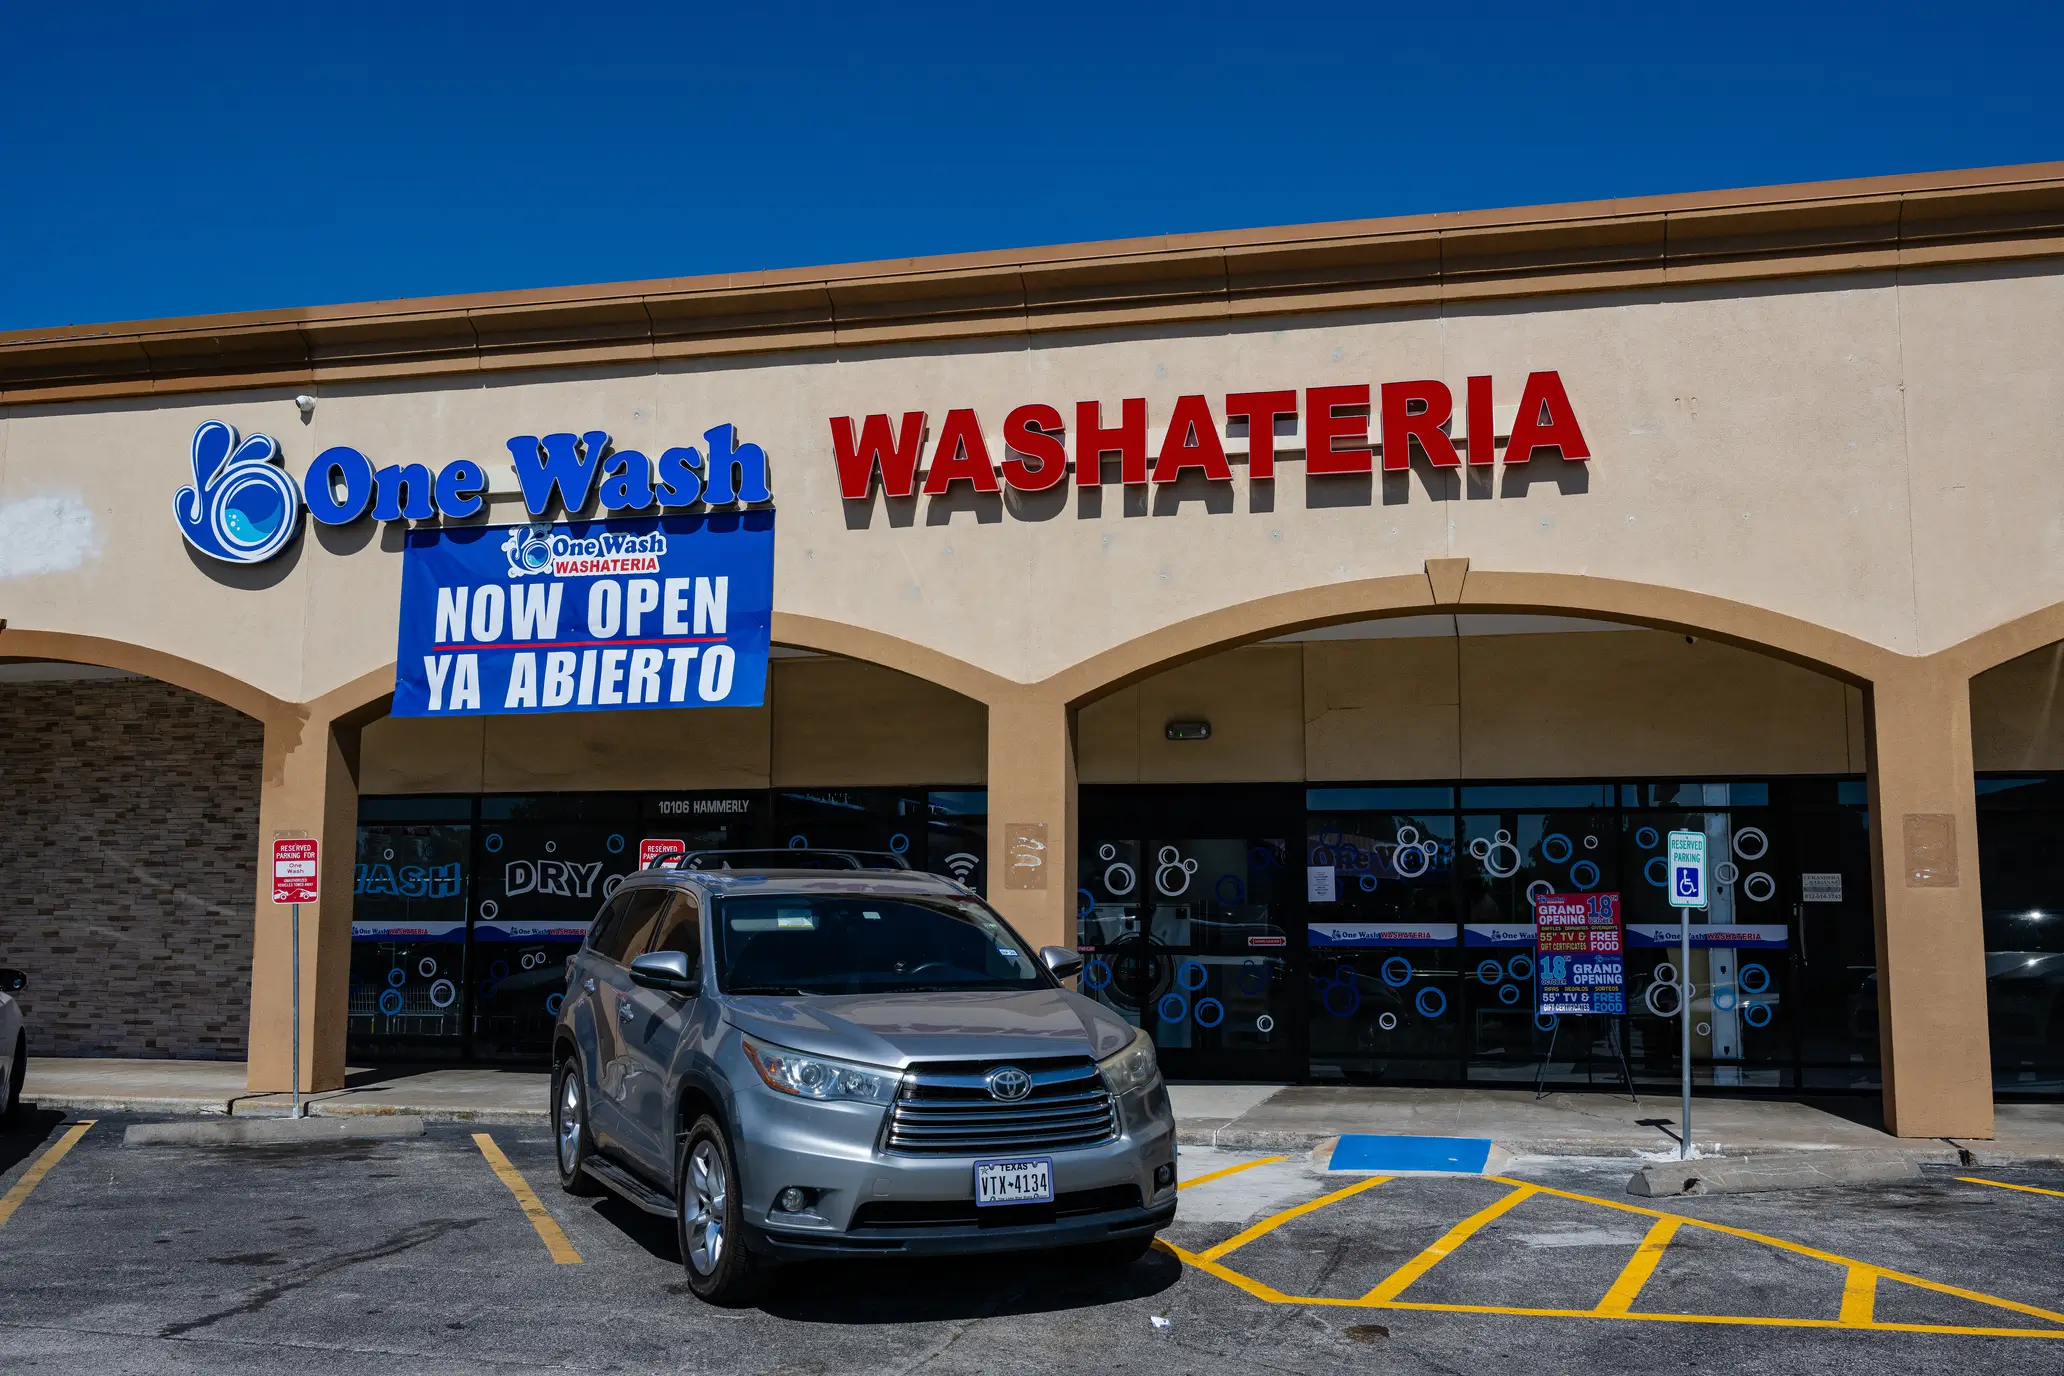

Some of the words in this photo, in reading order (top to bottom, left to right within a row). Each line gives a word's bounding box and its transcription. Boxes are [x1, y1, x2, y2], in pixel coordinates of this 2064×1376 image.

[829, 370, 1590, 500] WASHATERIA
[303, 446, 489, 526] One
[506, 422, 774, 515] Wash
[552, 538, 598, 557] One
[602, 532, 665, 555] Wash
[555, 557, 658, 574] WASHATERIA
[435, 582, 564, 643] NOW
[587, 576, 729, 639] OPEN
[423, 653, 481, 711] YA
[504, 644, 736, 708] ABIERTO
[658, 800, 690, 814] 10106
[693, 799, 750, 814] HAMMERLY
[647, 845, 678, 853] RESERVED
[1671, 839, 1703, 851] RESERVED
[1673, 852, 1701, 863] PARKING
[505, 860, 604, 898] DRY
[1538, 904, 1585, 914] GRAND
[1538, 915, 1586, 925] OPENING
[1540, 932, 1557, 941] 55"
[1560, 932, 1574, 940] TV
[1578, 932, 1586, 940] &
[1590, 932, 1618, 940] FREE
[1707, 933, 1761, 941] WASHATERIA
[1541, 942, 1552, 950] GIFT
[1553, 942, 1586, 950] CERTIFICATES
[1591, 942, 1619, 950] FOOD
[1573, 964, 1622, 974] GRAND
[1574, 974, 1623, 984] OPENING
[1542, 993, 1560, 1002] 55"
[1563, 993, 1578, 1002] TV
[1581, 993, 1590, 1002] &
[1594, 992, 1622, 1002] FREE
[1543, 1003, 1555, 1012] GIFT
[1556, 1003, 1590, 1012] CERTIFICATES
[1594, 1003, 1623, 1012] FOOD
[1000, 1163, 1028, 1172] TEXAS
[981, 1175, 1006, 1196] VTX
[1014, 1173, 1047, 1194] 4134
